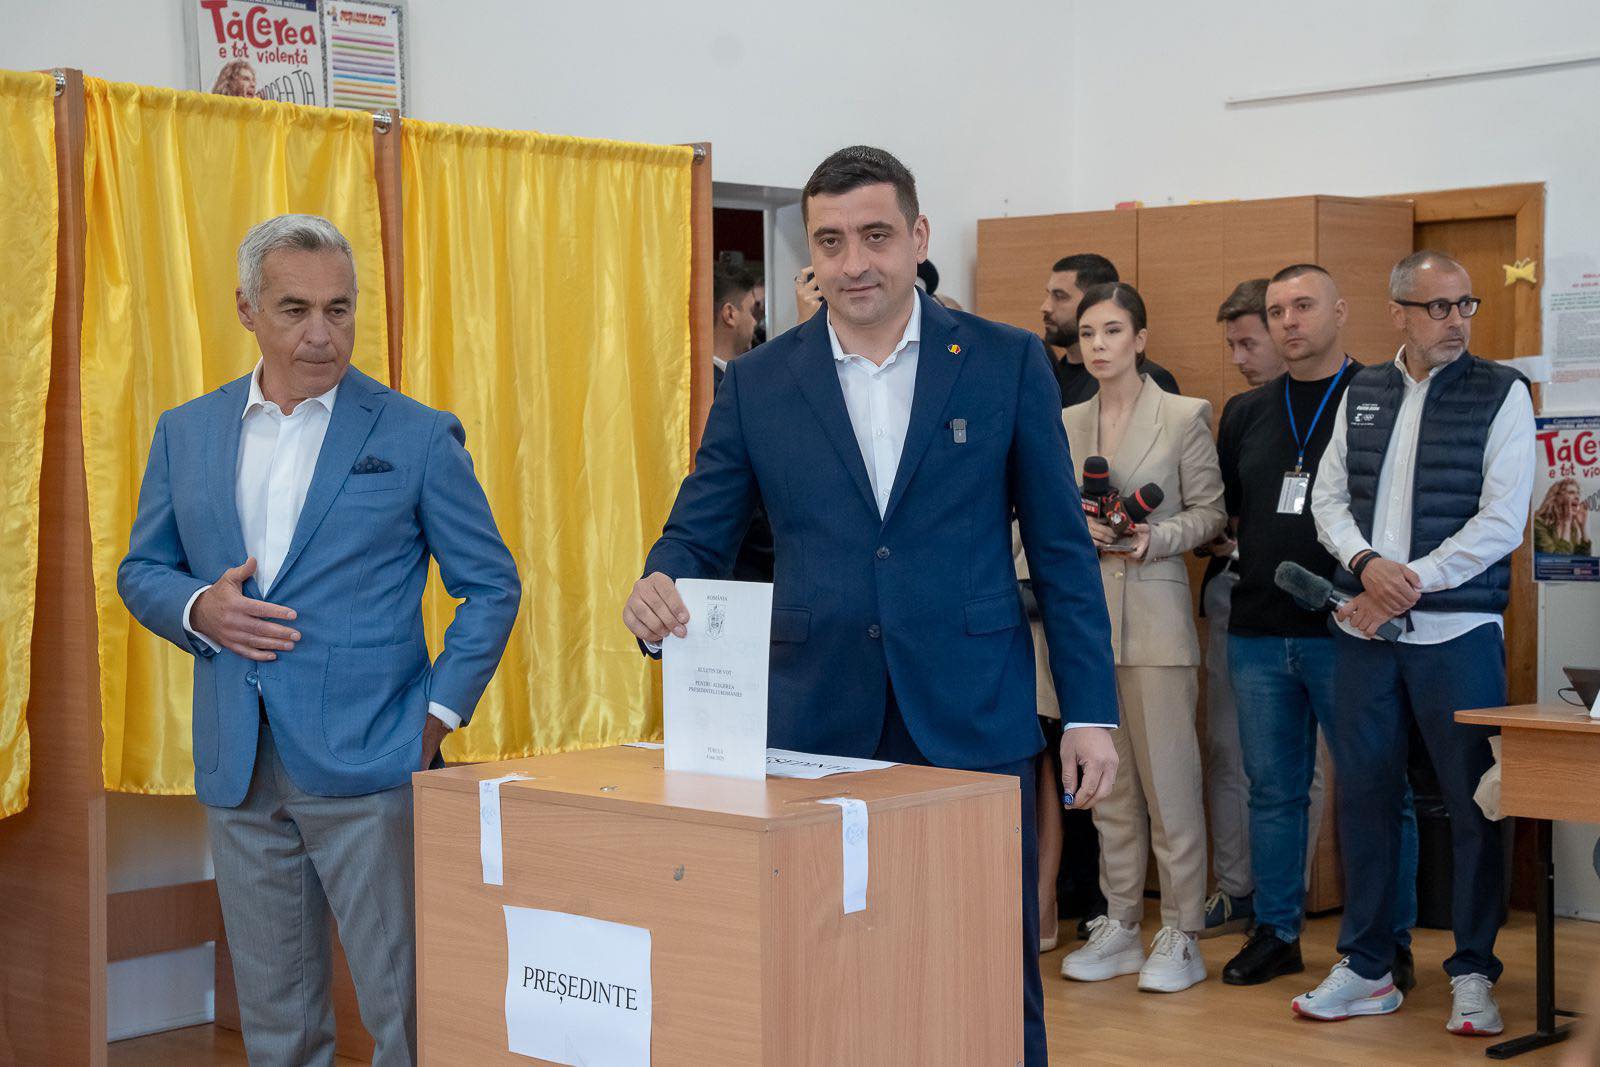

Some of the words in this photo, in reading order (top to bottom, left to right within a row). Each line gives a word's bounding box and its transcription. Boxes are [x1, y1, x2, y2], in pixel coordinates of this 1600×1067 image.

[219, 46, 227, 58] e
[231, 42, 249, 58] tot
[1536, 431, 1600, 467] TăCe
[523, 966, 638, 1011] PREȘEDINTE
